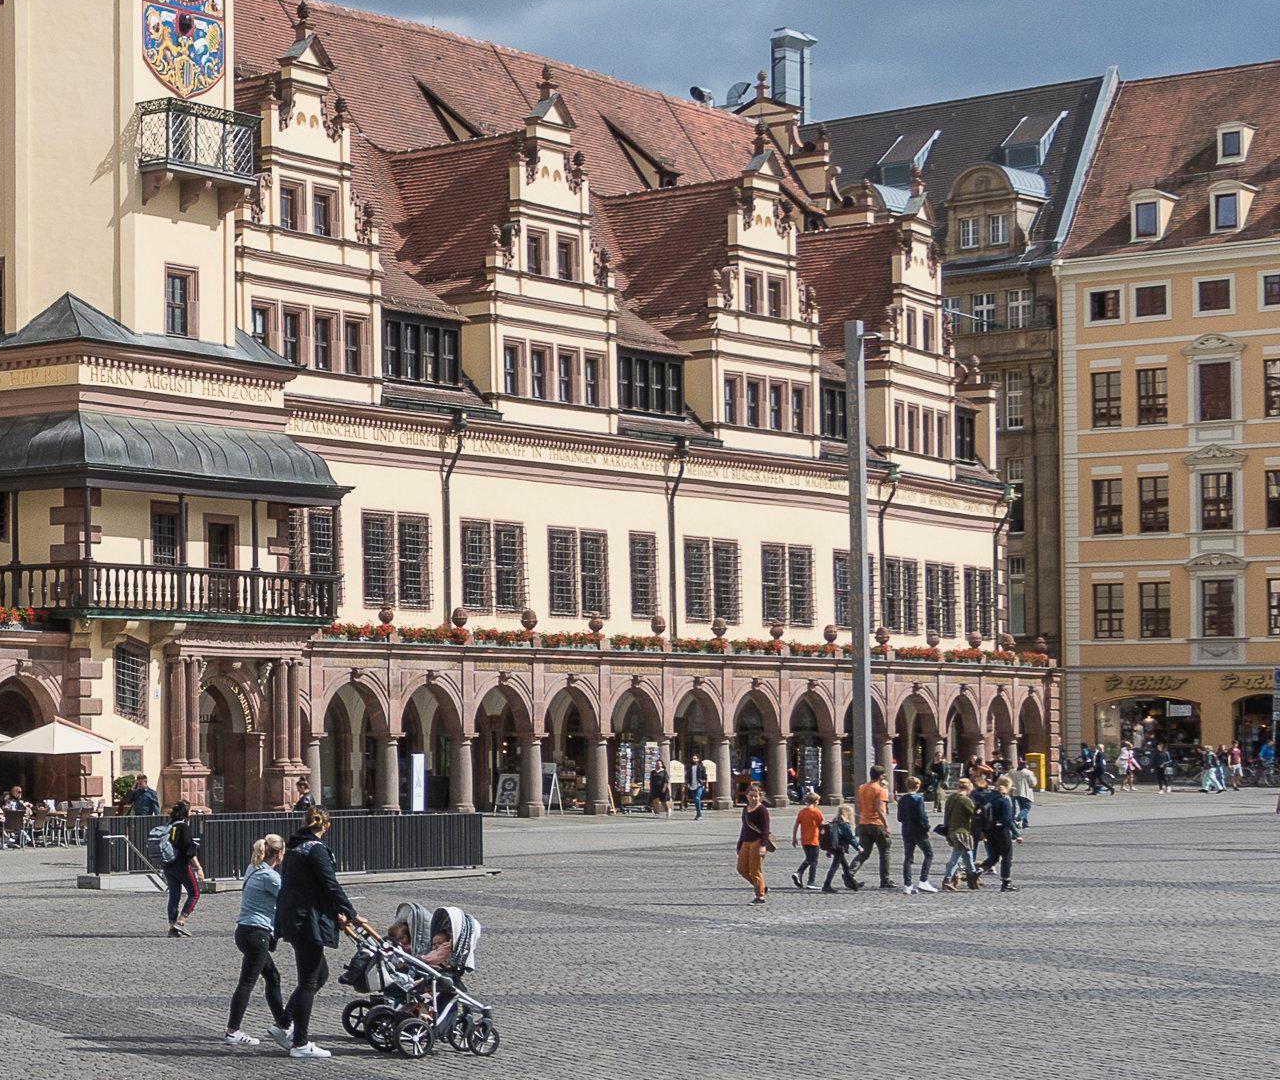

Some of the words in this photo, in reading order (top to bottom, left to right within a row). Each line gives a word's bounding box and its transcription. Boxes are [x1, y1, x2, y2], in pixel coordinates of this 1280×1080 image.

[90, 367, 134, 386] HERRN
[202, 383, 273, 403] HERTZOGEN
[373, 428, 395, 443] UND
[1127, 675, 1188, 690] Tchibo
